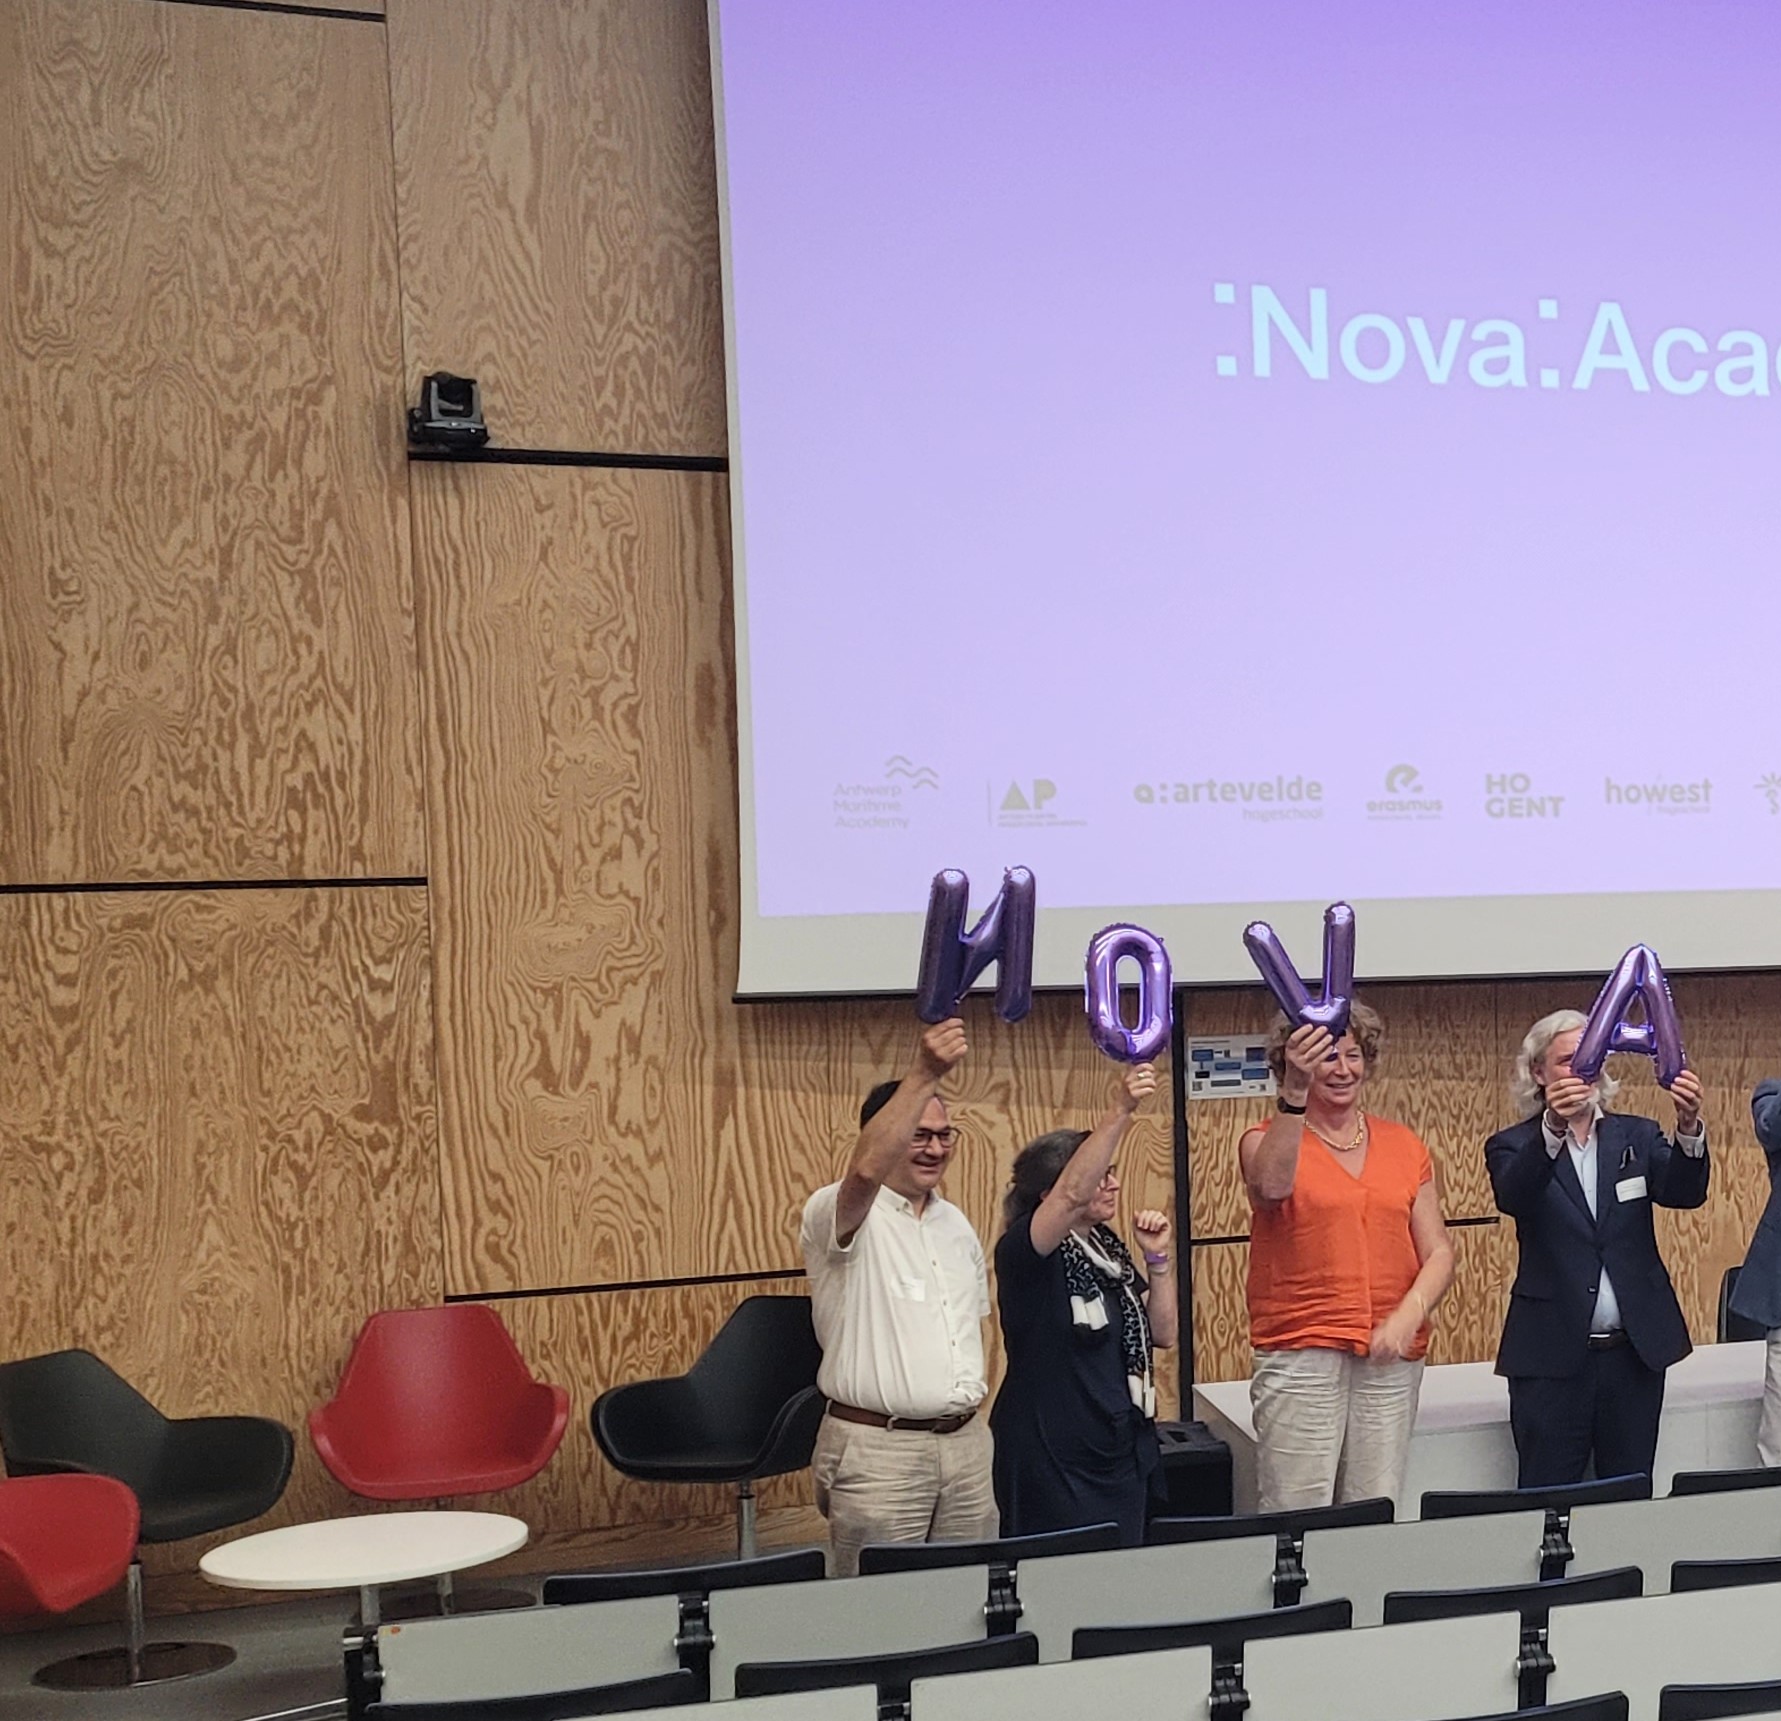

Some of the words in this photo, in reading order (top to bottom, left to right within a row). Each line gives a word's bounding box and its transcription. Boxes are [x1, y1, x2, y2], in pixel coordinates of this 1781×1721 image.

[1485, 772, 1531, 794] HO
[1605, 776, 1713, 805] howest
[1366, 798, 1443, 812] erasmus
[1484, 796, 1565, 818] GENT
